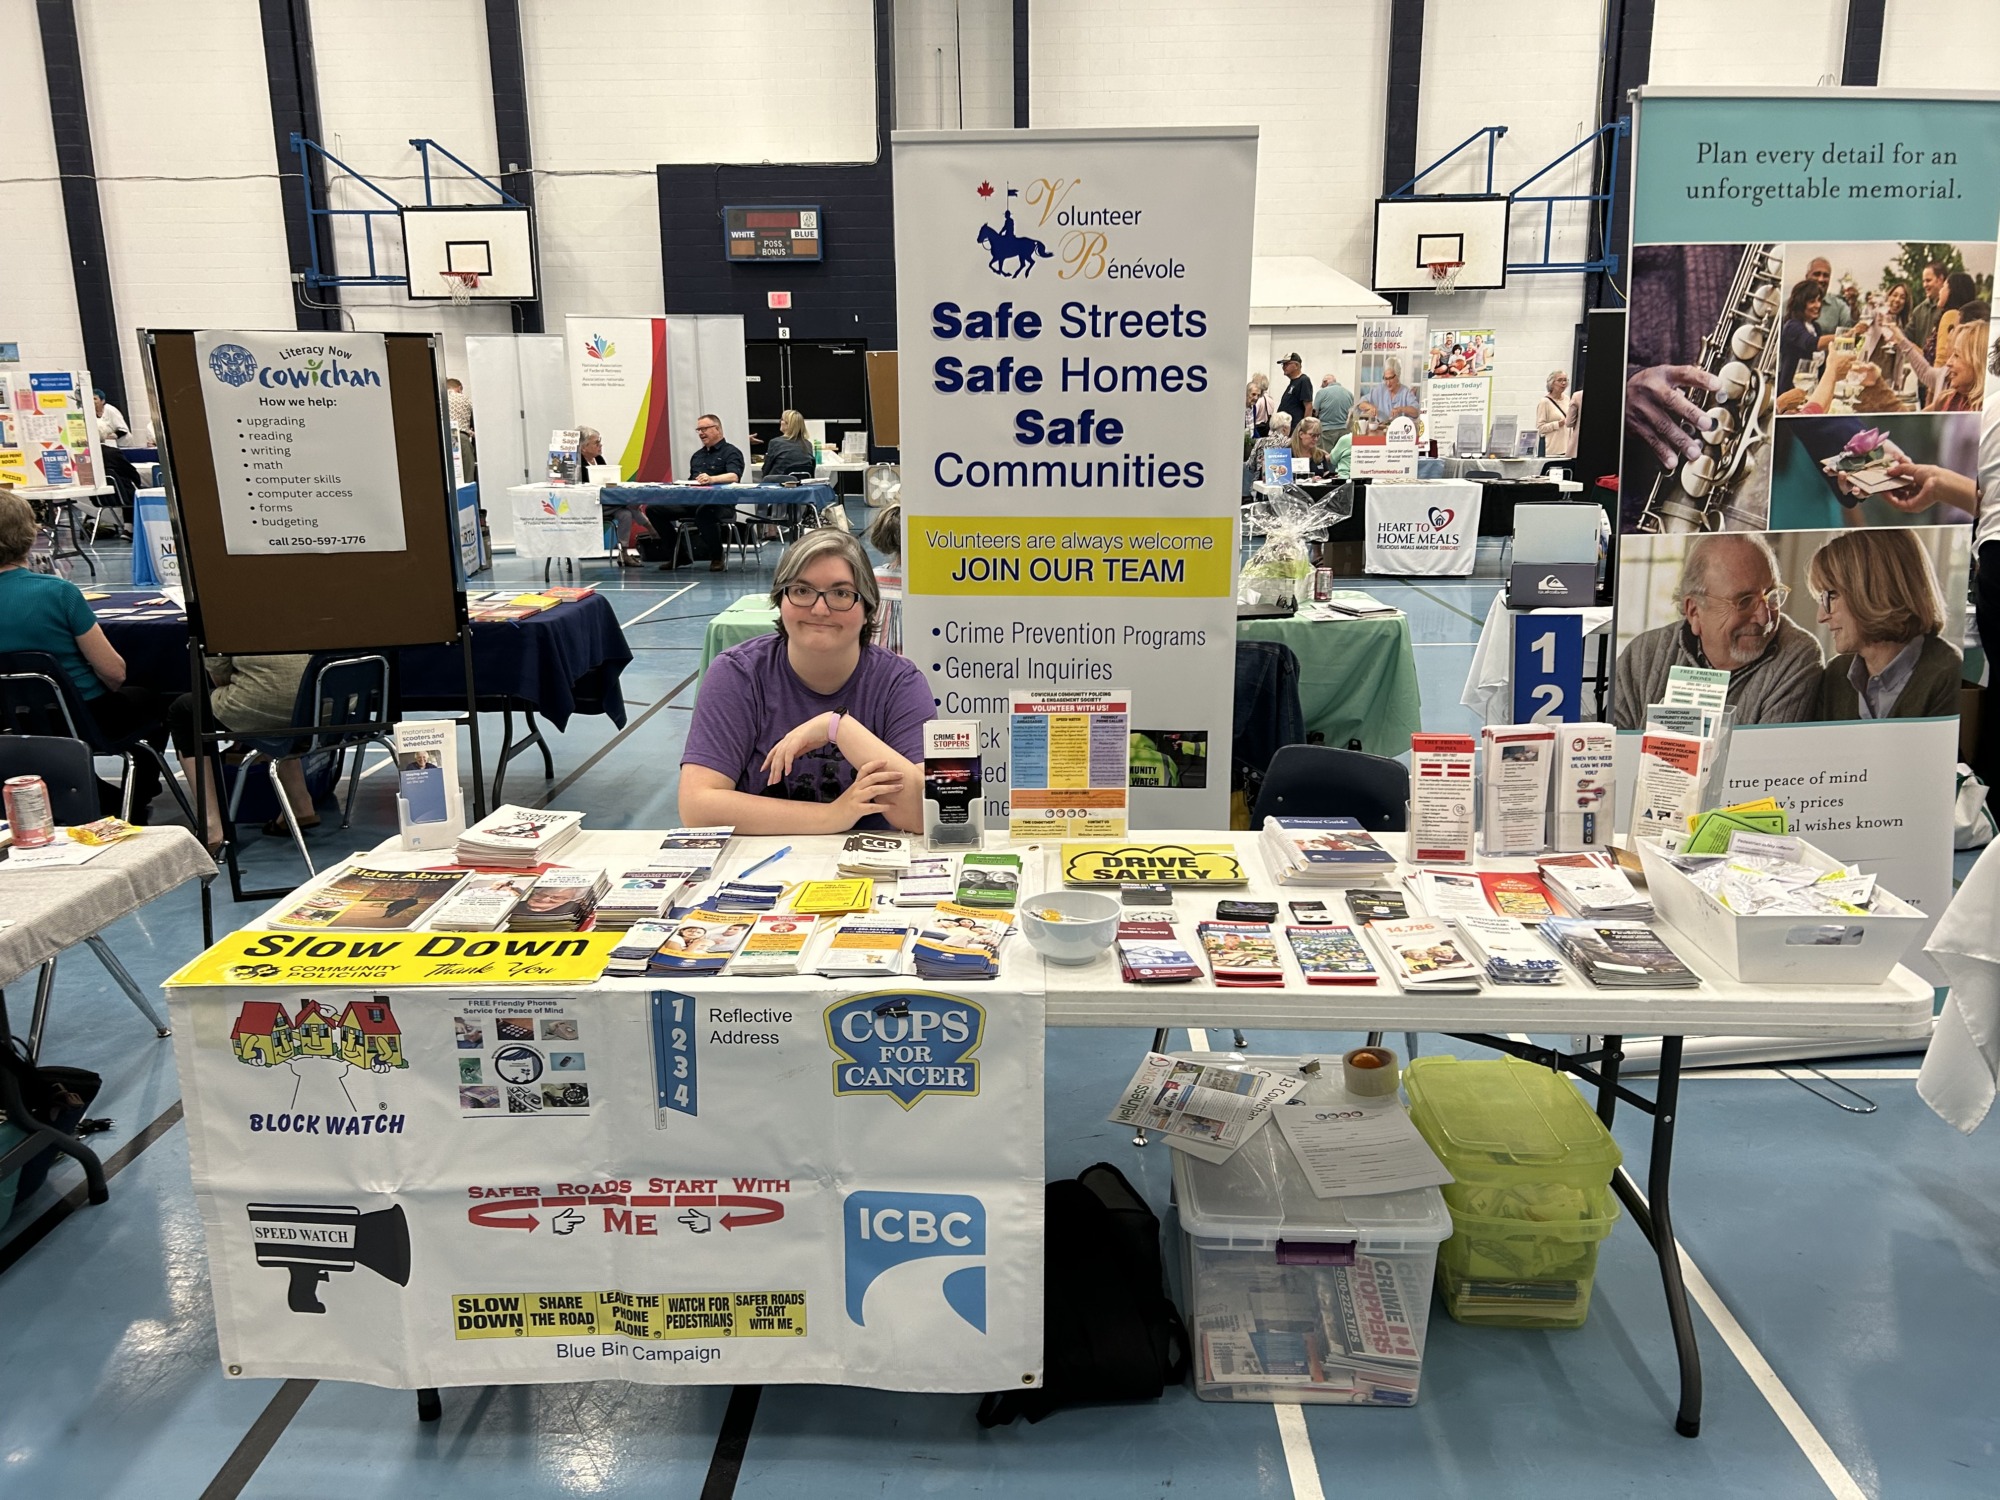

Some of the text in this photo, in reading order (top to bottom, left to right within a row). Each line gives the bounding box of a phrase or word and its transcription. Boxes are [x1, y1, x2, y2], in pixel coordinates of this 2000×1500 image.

[1696, 141, 1958, 172] Plan every detail for an
[1685, 178, 1962, 207] unforgettable memorial.
[1025, 178, 1142, 228] Volunteer
[794, 230, 815, 238] BLUE
[762, 248, 786, 256] BONUS
[1057, 230, 1185, 280] Bénévole
[930, 302, 1207, 340] Safe Streets
[781, 329, 787, 337] 8
[1362, 326, 1404, 338] Meals made
[278, 345, 353, 361] Literacy Now
[1360, 340, 1408, 353] for seniors...
[933, 356, 1208, 394] Safe Homes
[259, 396, 337, 409] How we help:
[246, 416, 306, 428] upgrading
[1014, 408, 1124, 447] Safe
[248, 431, 294, 442] reading
[250, 446, 292, 458] writing
[253, 460, 283, 470] math
[934, 452, 1204, 489] Communities
[255, 474, 342, 486] computer skills
[257, 490, 353, 500] computer access
[259, 504, 293, 512] forms
[261, 517, 319, 528] budgeting
[1378, 522, 1430, 532] HEART TO
[268, 536, 366, 546] call 250-597-1776
[925, 530, 1214, 554] Volunteers are always welcome
[1377, 533, 1460, 545] HOME MEALS
[951, 557, 1185, 583] JOIN OUR TEAM
[945, 621, 1207, 650] Crime Prevention Programs
[946, 656, 1113, 685] General Inquiries
[1032, 704, 1109, 712] VOLUNTEER WITH US!
[402, 734, 430, 742] scooters
[403, 740, 442, 748] wheelchairs
[934, 740, 970, 748] STOPPERS
[1729, 769, 1868, 791] true peace of mind
[1800, 797, 1844, 813] prices
[514, 815, 556, 824] SAFETY
[516, 810, 568, 821] SCOOTER
[1804, 816, 1904, 831] wishes known
[862, 838, 899, 850] CCR
[1102, 856, 1197, 868] DRIVE
[348, 867, 465, 880] Elder Abuse
[1092, 869, 1212, 880] SAFELY
[243, 936, 591, 957] Slow Down
[289, 964, 401, 972] COMMUNITY
[423, 962, 558, 978] Thank You
[492, 1000, 525, 1008] Friendly
[709, 1007, 793, 1024] Reflective
[841, 1010, 970, 1043] COPS
[709, 1030, 780, 1046] Address
[879, 1046, 933, 1064] FOR
[845, 1066, 968, 1087] CANCER
[1116, 1066, 1162, 1121] wellness NEWS
[1248, 1088, 1286, 1121] Cowichan
[249, 1114, 405, 1136] BLOCK WATCH
[468, 1177, 791, 1199] SAFER ROADS START WITH
[603, 1207, 658, 1236] ME
[860, 1206, 972, 1246] ICBC
[255, 1226, 348, 1243] SPEED WATCH
[600, 1292, 660, 1308] LEAVE THE
[1374, 1260, 1405, 1324] CRIME
[458, 1297, 520, 1314] SLOW
[538, 1296, 583, 1310] SHARE
[668, 1297, 730, 1313] WATCH FOR
[736, 1294, 805, 1307] SAFER ROADS
[1356, 1257, 1394, 1355] STOPPERS
[530, 1313, 595, 1327] THE ROAD
[612, 1306, 649, 1323] PHONE
[755, 1306, 786, 1318] START
[458, 1314, 524, 1331] DOWN
[614, 1320, 650, 1337] ALONE
[666, 1313, 734, 1330] PEDESTRIANS
[749, 1318, 793, 1330] WITH ME
[556, 1341, 722, 1364] Blue Bin Campaign
